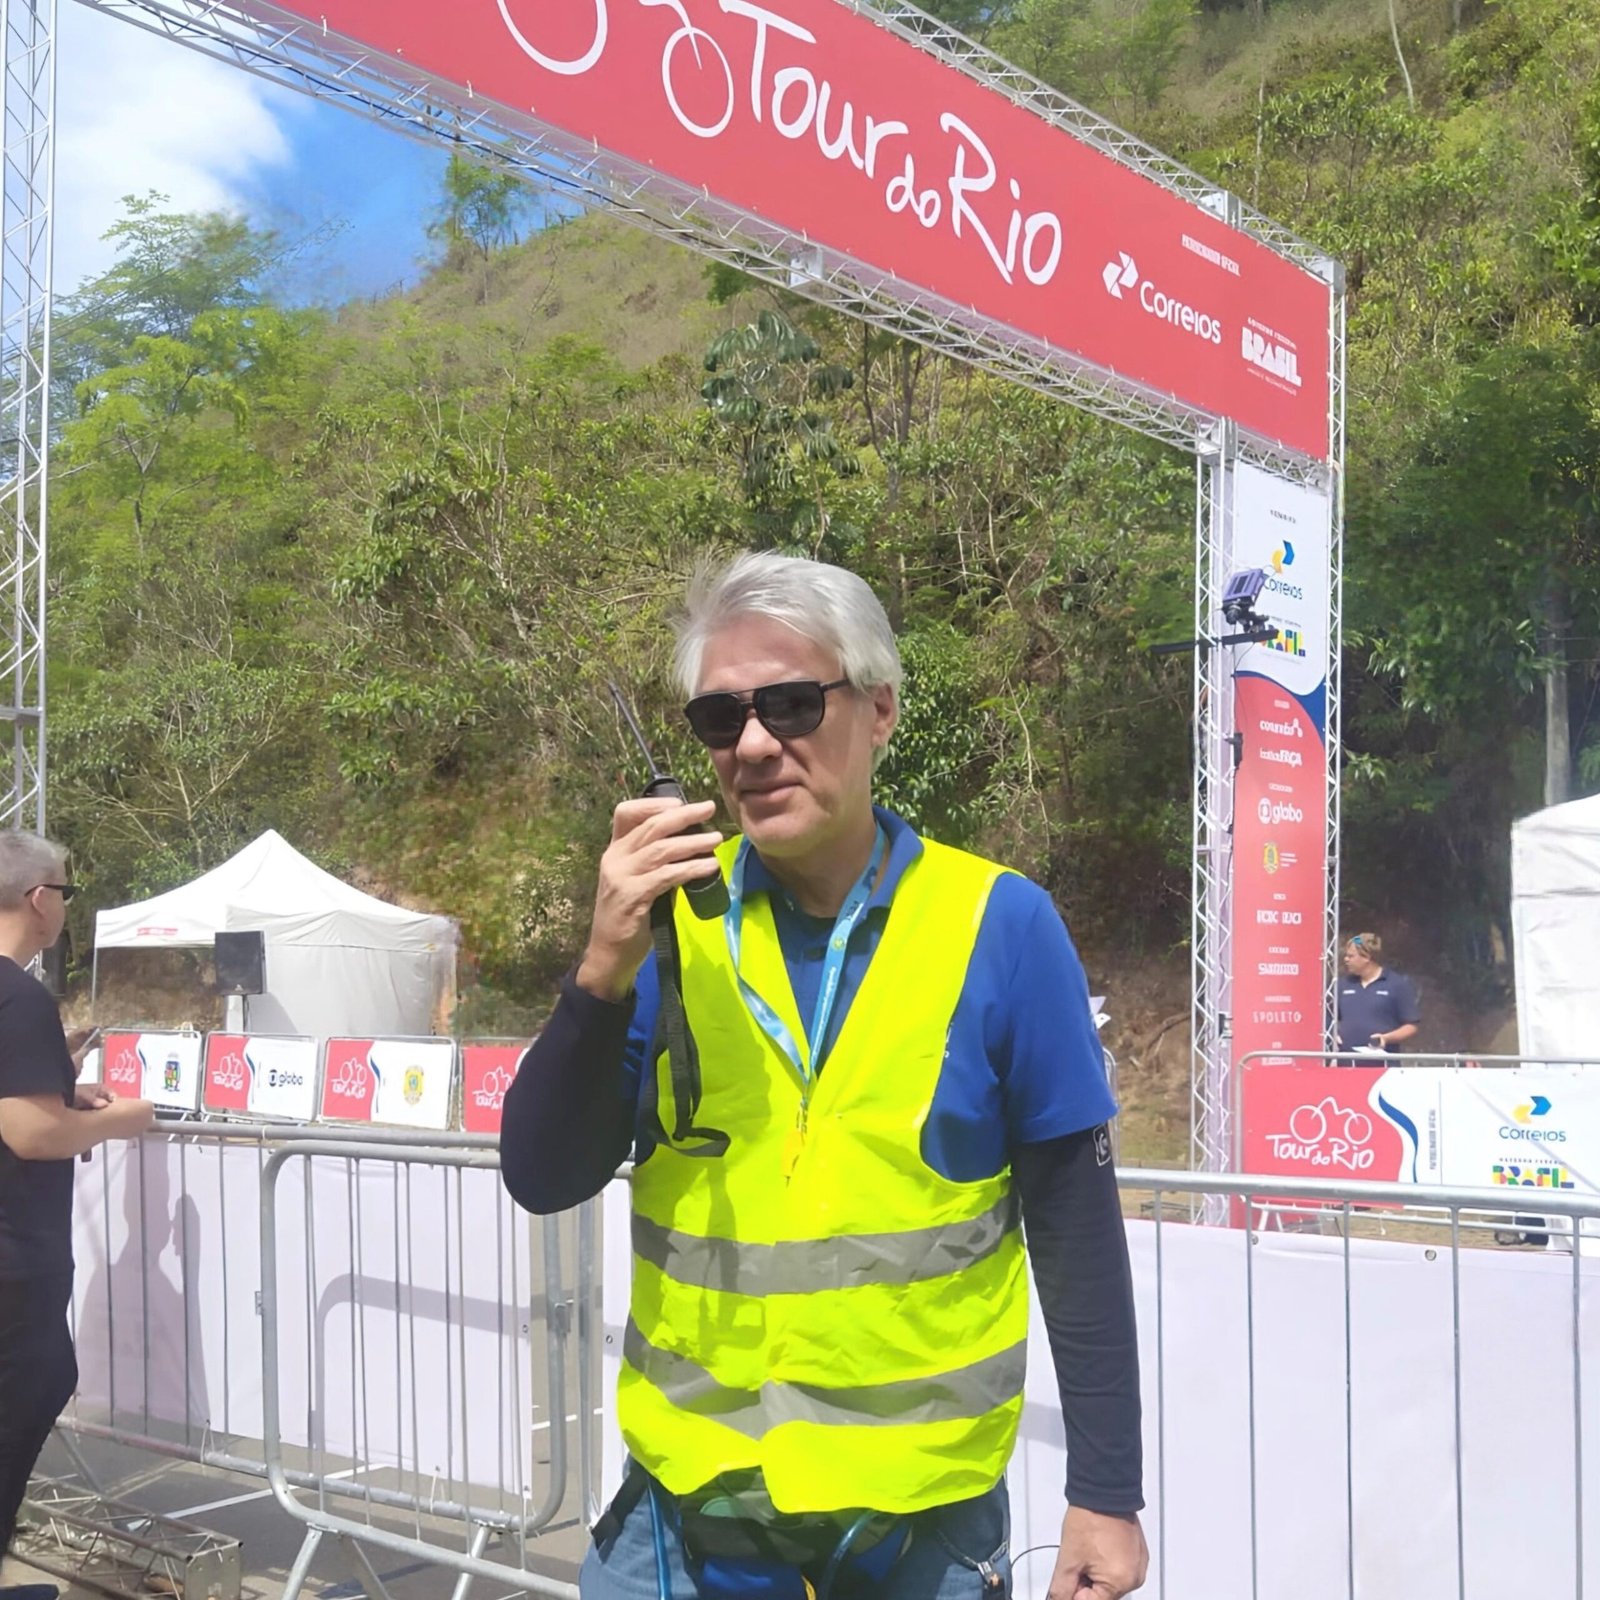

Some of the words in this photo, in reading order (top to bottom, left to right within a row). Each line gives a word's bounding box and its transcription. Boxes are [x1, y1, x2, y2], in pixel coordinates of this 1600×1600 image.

[718, 0, 909, 179] Tour
[885, 153, 942, 228] do
[939, 111, 1062, 286] Rio
[1139, 280, 1222, 345] Correios
[1241, 326, 1302, 388] BRASIL
[1272, 800, 1303, 824] globo
[1252, 1011, 1302, 1024] SPOLETO
[279, 1071, 303, 1087] globo
[1498, 1126, 1567, 1142] Correios
[1265, 1134, 1319, 1160] Tour
[1311, 1152, 1331, 1166] do
[1328, 1137, 1375, 1171] Rio
[1492, 1165, 1574, 1189] BRASIL
